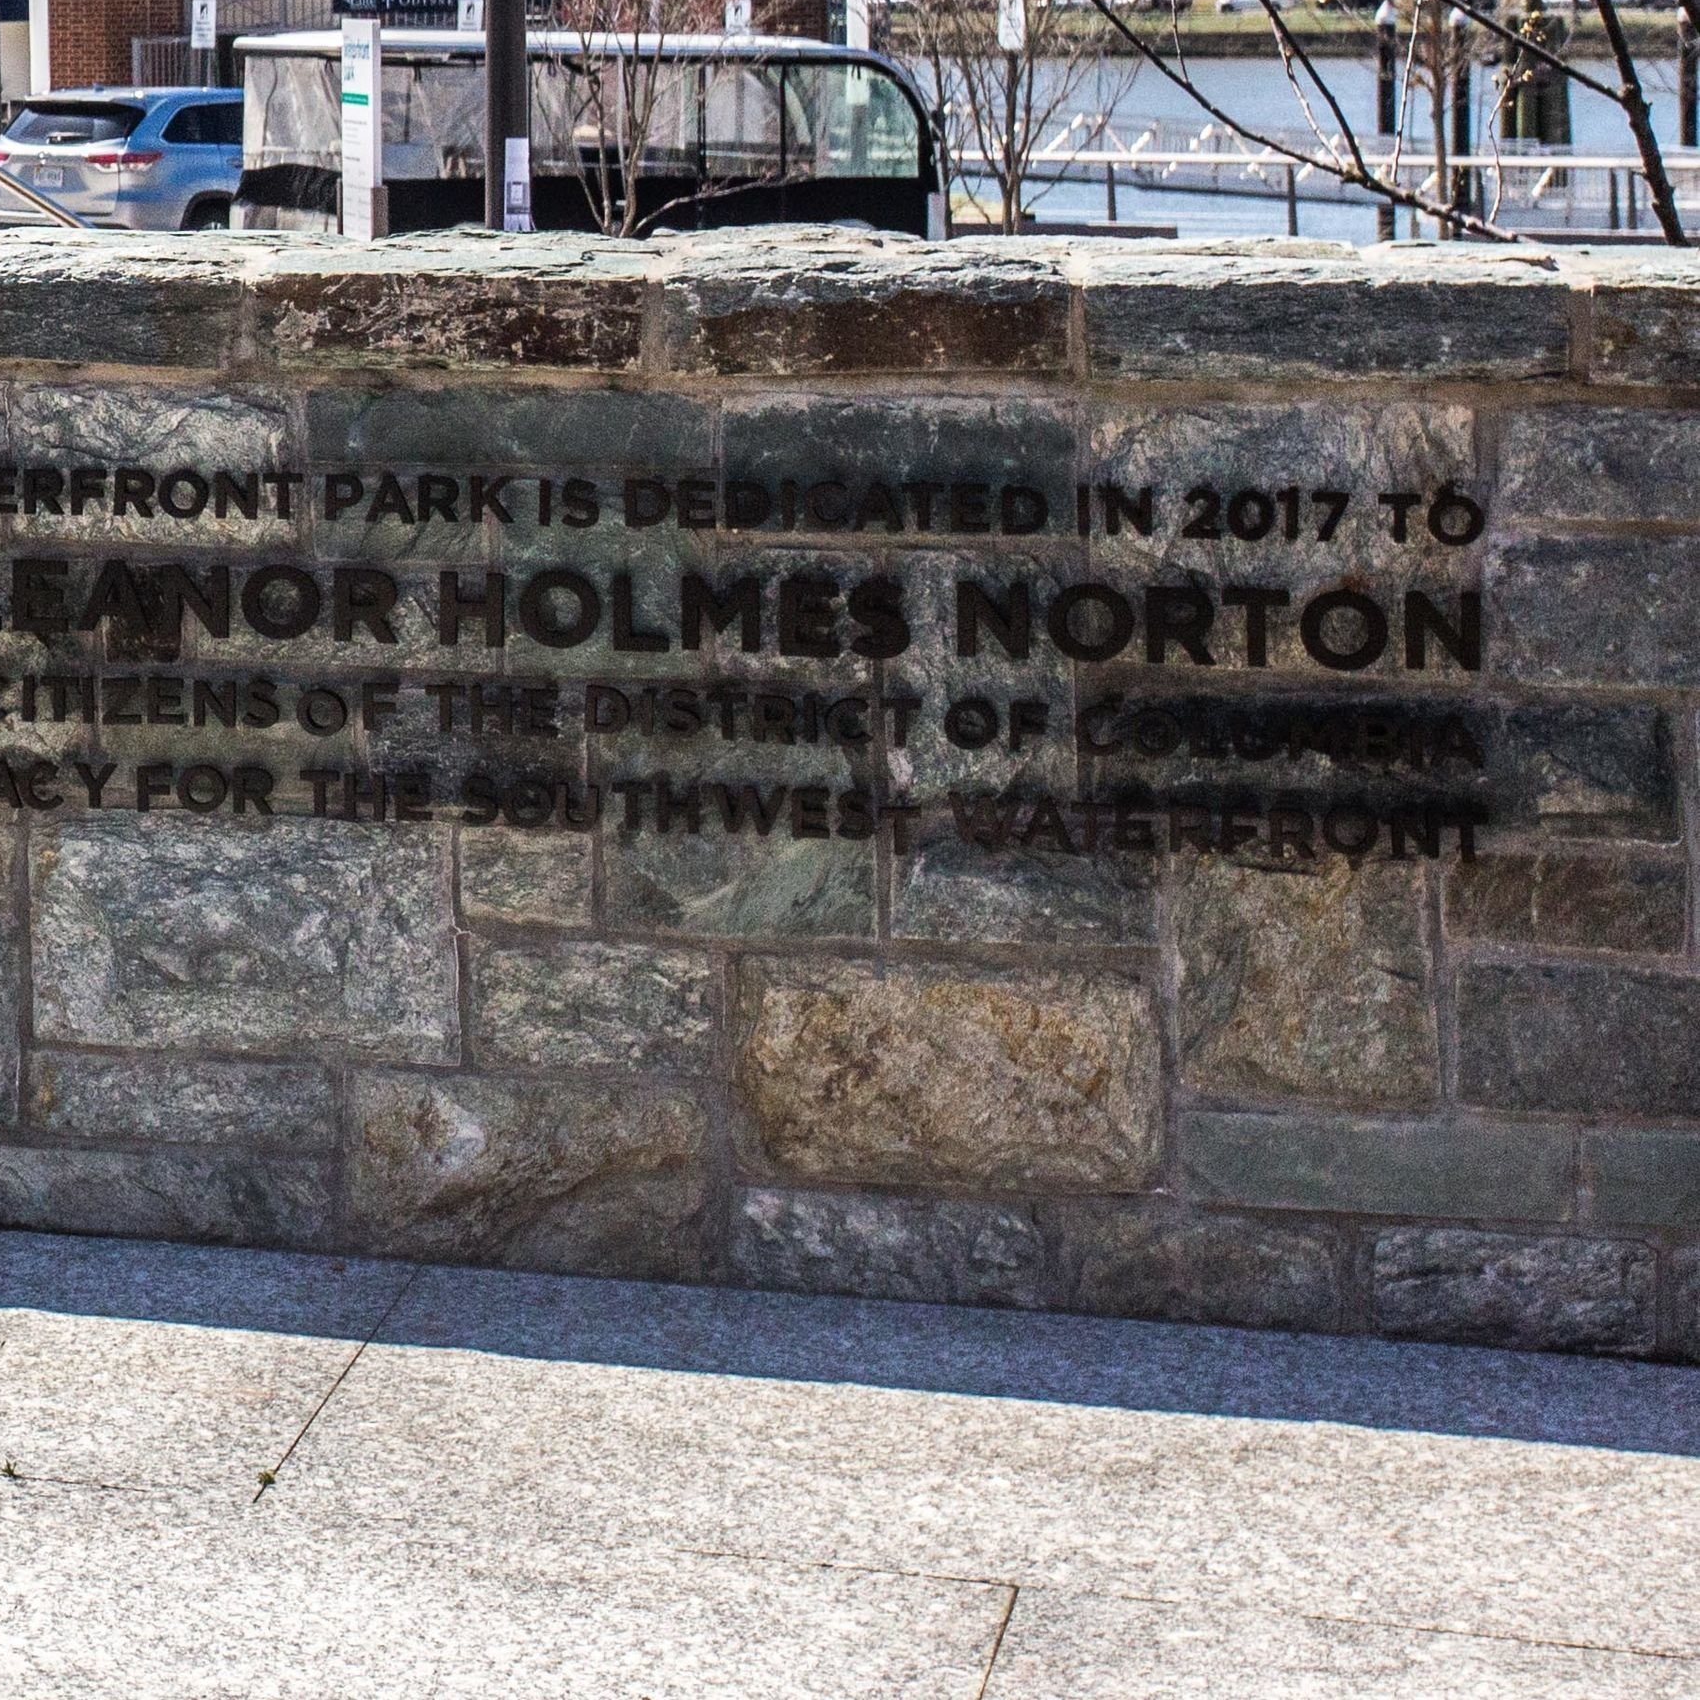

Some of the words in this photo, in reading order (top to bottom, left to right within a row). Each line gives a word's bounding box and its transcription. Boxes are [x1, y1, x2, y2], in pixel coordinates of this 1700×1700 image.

[324, 472, 512, 526] PARK
[539, 478, 600, 529] IS
[624, 478, 1050, 535] DEDICATED
[1077, 485, 1153, 537] IN
[1181, 489, 1351, 542] 2017
[1378, 488, 1486, 546] TO
[439, 567, 912, 658] HOLMES
[956, 580, 1481, 671] NORTON
[300, 684, 397, 737] OF
[425, 684, 558, 738] THE
[582, 683, 919, 749] DISTRICT
[944, 701, 1050, 751] OF
[137, 762, 276, 816] FOR
[300, 769, 434, 822] THE
[461, 775, 922, 854] SOUTHWEST
[946, 790, 1489, 863] WATERFRONT
